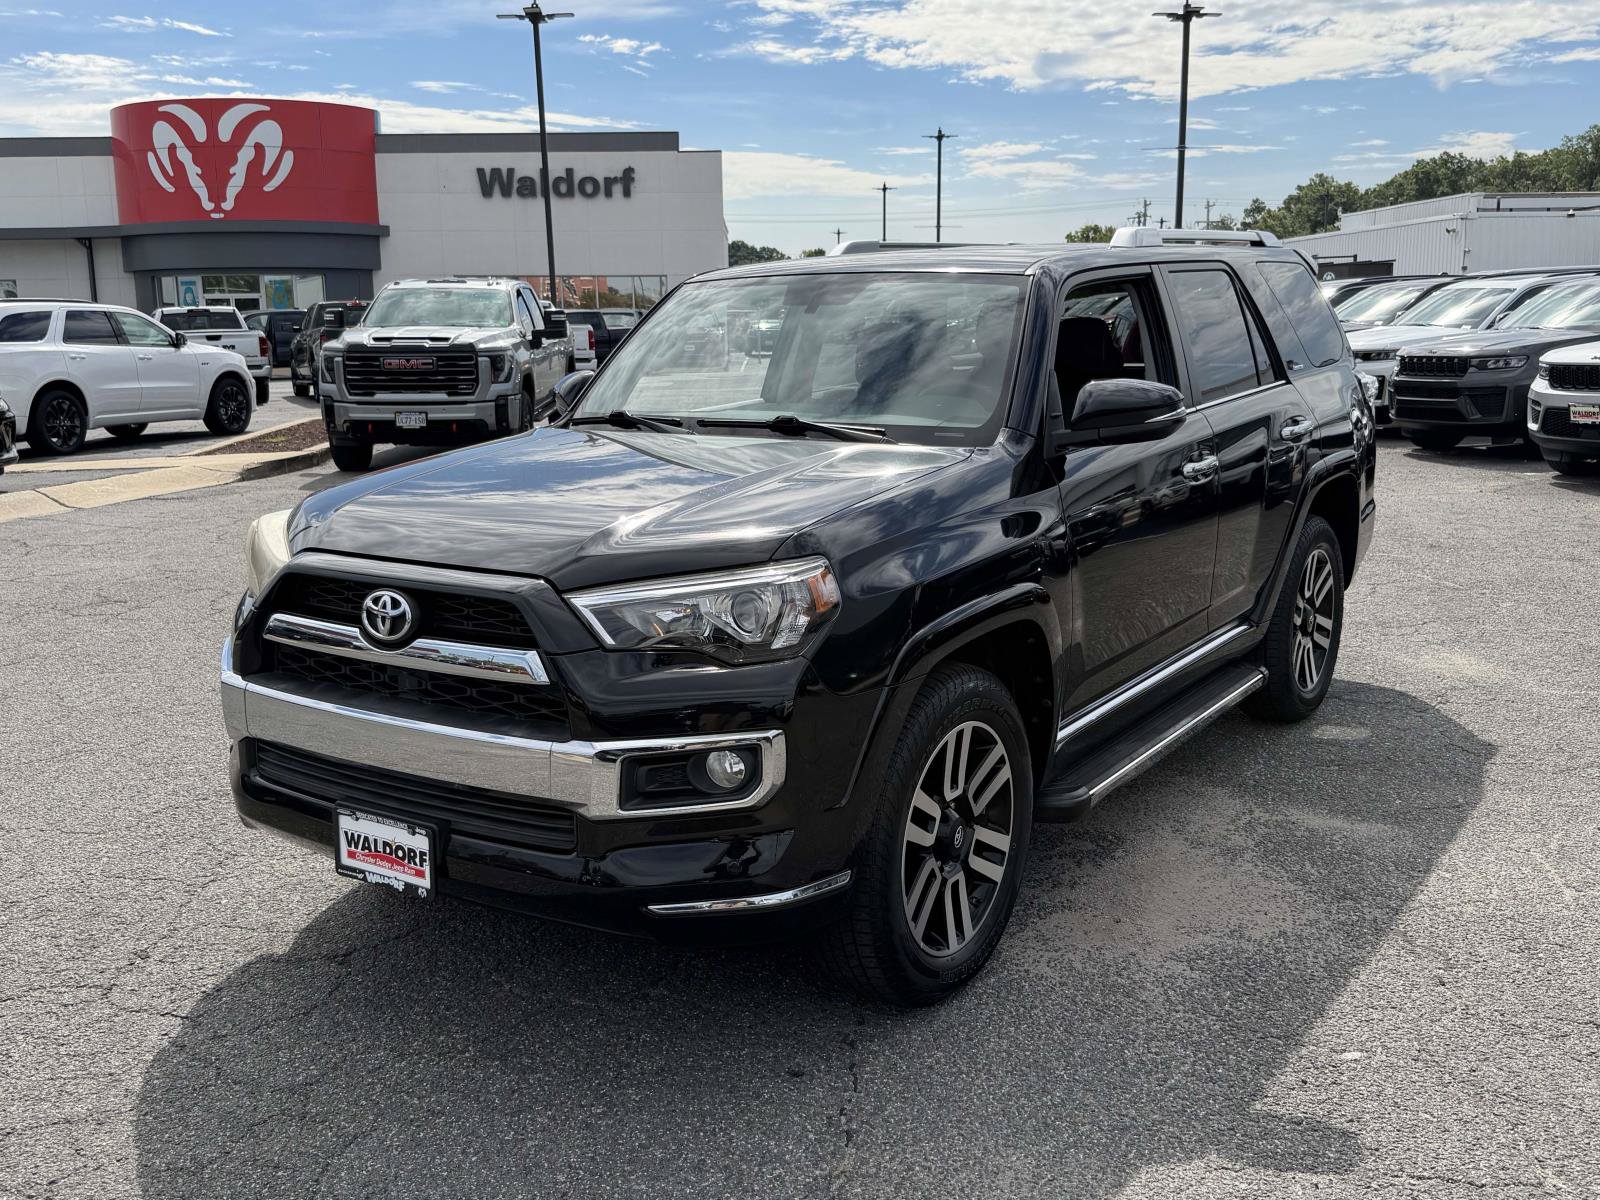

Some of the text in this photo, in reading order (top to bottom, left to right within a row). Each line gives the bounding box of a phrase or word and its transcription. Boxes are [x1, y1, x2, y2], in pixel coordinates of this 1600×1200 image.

[476, 166, 635, 198] Waldorf
[384, 359, 433, 369] GMC
[344, 830, 428, 868] WALDORF
[355, 852, 416, 875] Chrysler Dodge Jeep Ram
[365, 871, 405, 892] WALDORF
